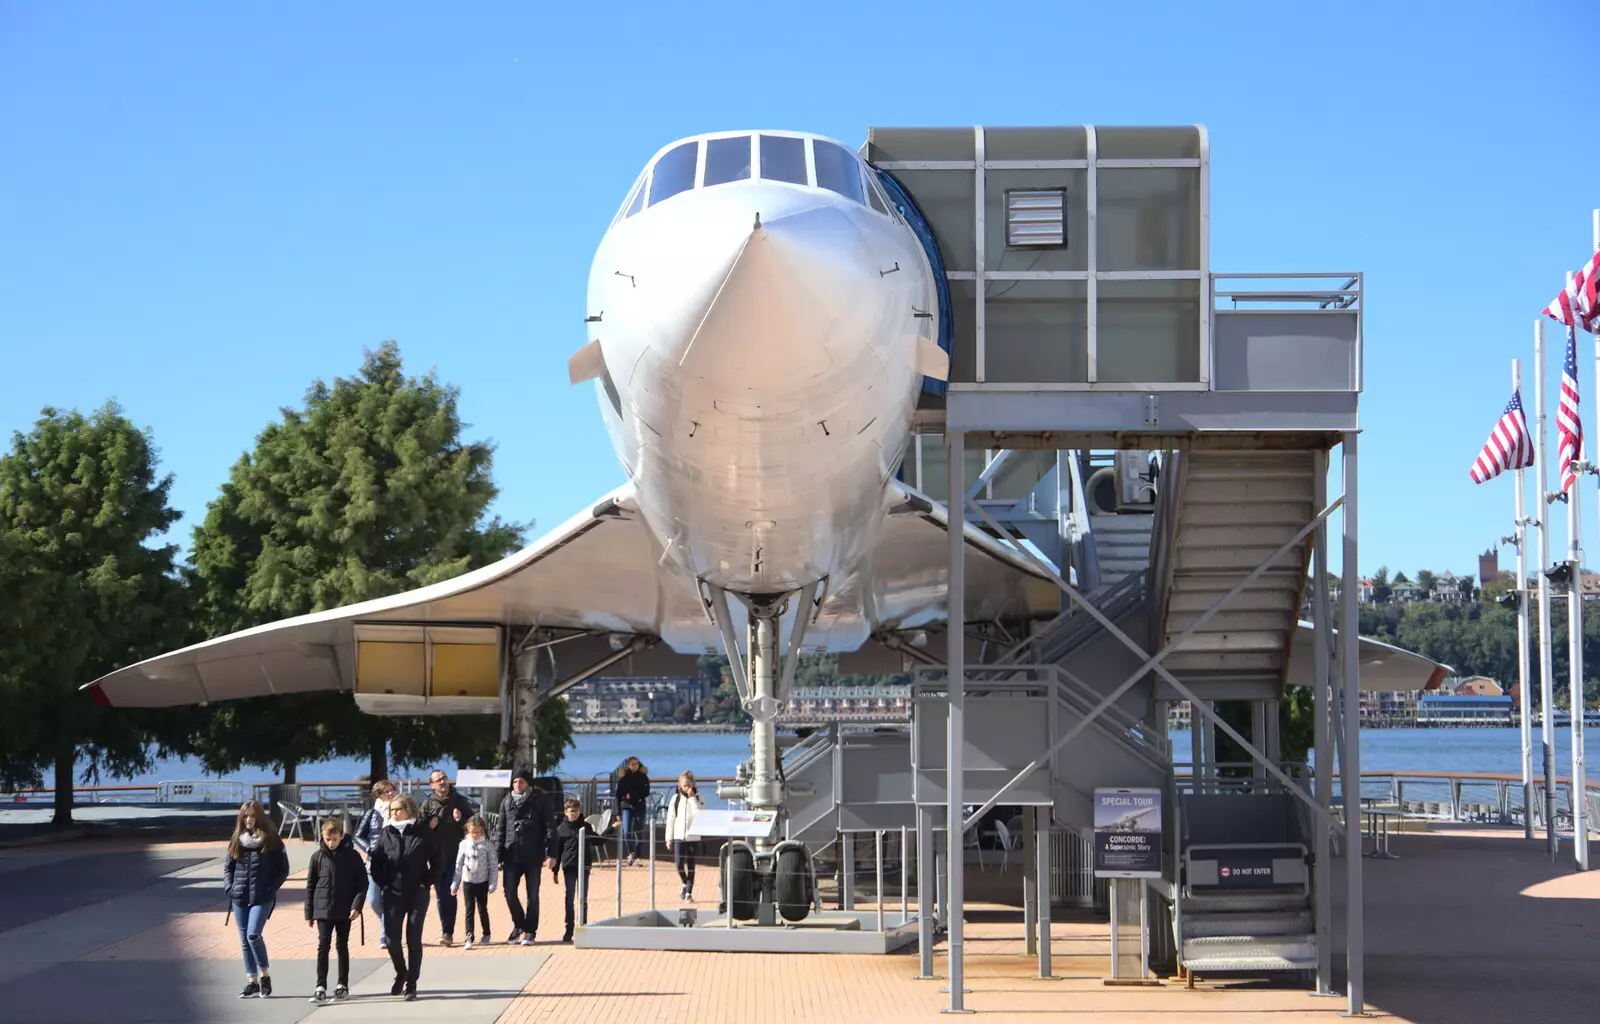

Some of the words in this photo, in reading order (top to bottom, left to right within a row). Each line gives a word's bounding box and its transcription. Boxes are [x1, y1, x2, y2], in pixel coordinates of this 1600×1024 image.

[1102, 797, 1131, 805] SPECIAL
[1133, 797, 1153, 805] TOUR
[1110, 835, 1146, 843] CONCORDE:
